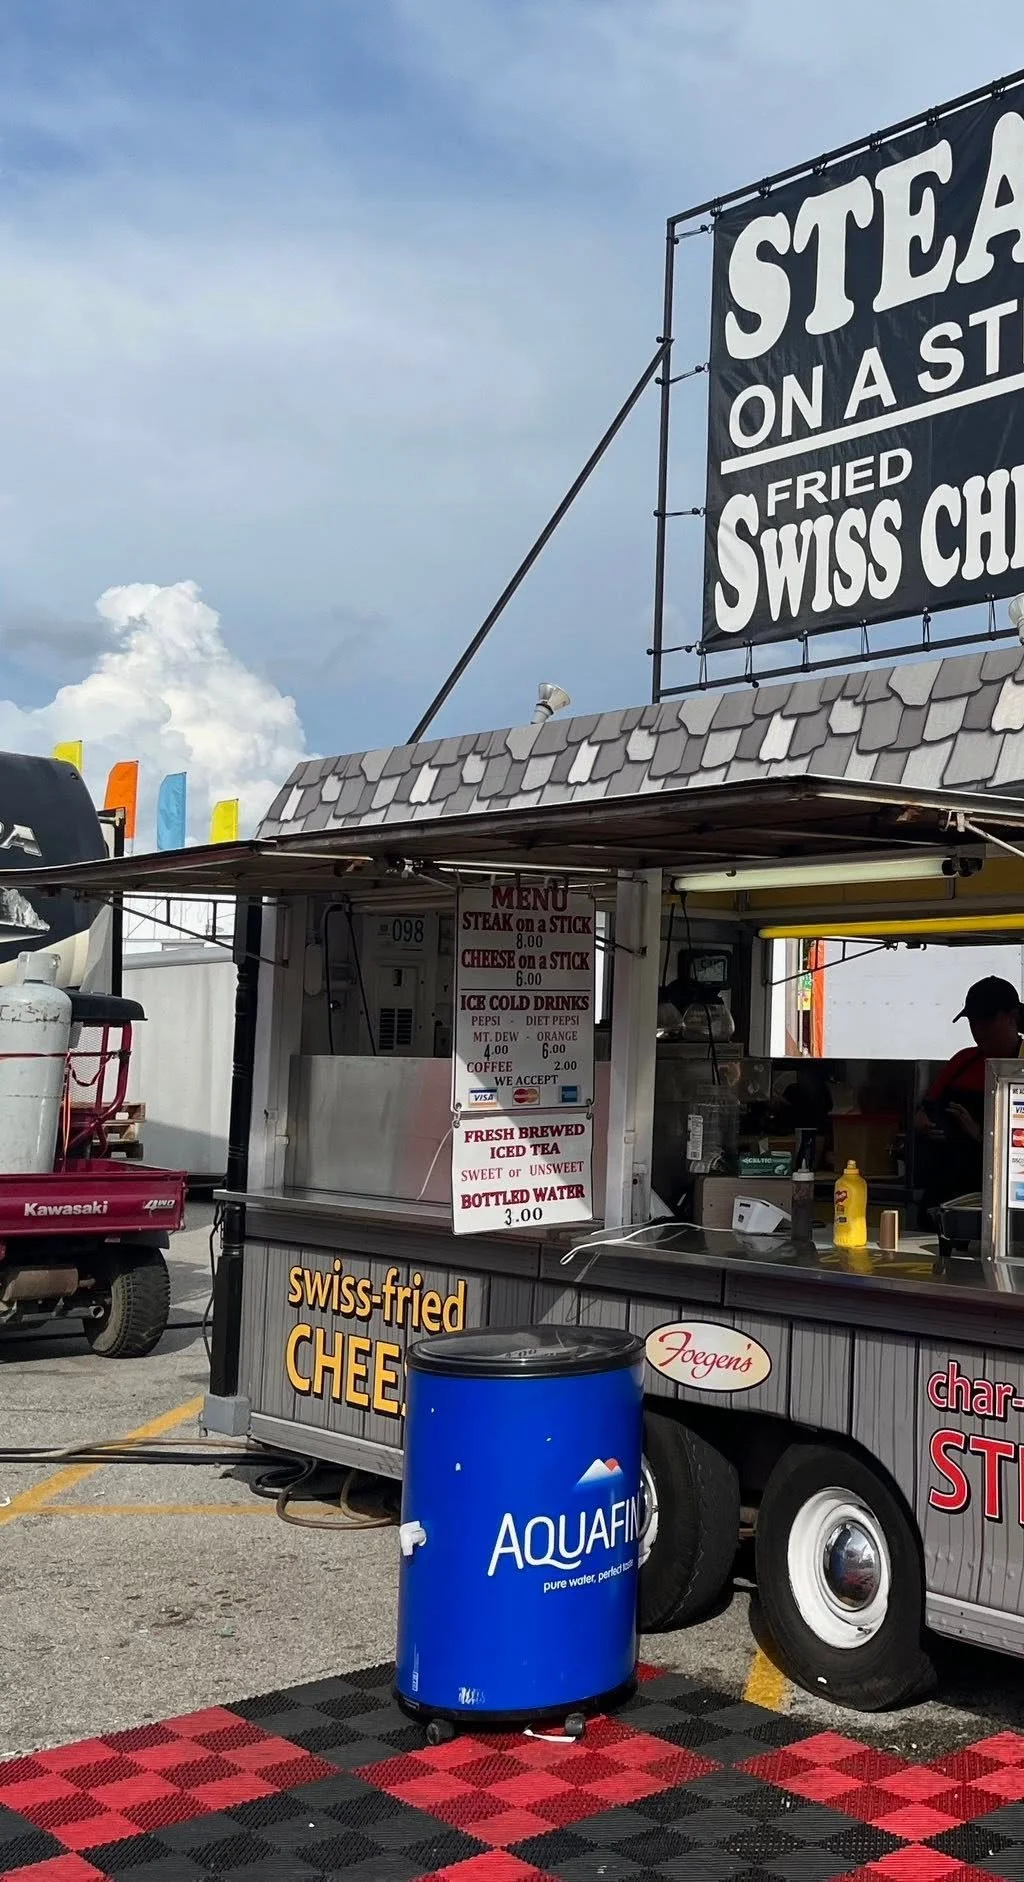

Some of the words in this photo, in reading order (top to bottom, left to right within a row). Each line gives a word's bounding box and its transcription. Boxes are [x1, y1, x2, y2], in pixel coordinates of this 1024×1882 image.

[729, 366, 822, 449] ON
[844, 346, 897, 419] A
[767, 447, 912, 517] FRIED
[714, 494, 903, 633] SWISS
[490, 884, 569, 912] MENU
[393, 918, 424, 943] 098
[462, 911, 514, 931] STEAK
[516, 918, 535, 932] on
[538, 920, 546, 933] a
[549, 916, 593, 934] STICK
[516, 932, 543, 949] 8.00
[461, 949, 516, 969] CHEESE
[518, 955, 535, 969] on
[538, 957, 547, 969] a
[549, 951, 590, 970] STICK
[516, 970, 542, 987] 6.00
[460, 994, 485, 1011] ICE
[489, 994, 530, 1011] COLD
[533, 994, 590, 1011] DRINKS
[471, 1015, 501, 1026] PEPSI
[526, 1015, 551, 1026] DIET
[552, 1015, 580, 1026] PEPSI
[473, 1031, 492, 1042] MT.
[495, 1031, 519, 1042] DEW
[537, 1031, 578, 1042] ORANGE
[484, 1044, 509, 1061] 4.00
[542, 1042, 566, 1059] 6.00
[466, 1061, 513, 1073] COFFEE
[554, 1060, 577, 1071] 2.00
[494, 1076, 512, 1086] WE
[515, 1075, 558, 1086] ACCEPT
[474, 1093, 494, 1102] VISA
[464, 1127, 515, 1143] FRESH
[518, 1123, 586, 1140] BREWED
[490, 1144, 526, 1159] ICED
[530, 1142, 561, 1156] TEA
[461, 1167, 503, 1182] SWEET
[509, 1168, 522, 1178] or
[529, 1161, 585, 1177] UNSWEET
[143, 1199, 175, 1211] 4WD
[461, 1188, 530, 1209] BOTTLED
[533, 1184, 586, 1202] WATER
[24, 1201, 108, 1217] Kawasaki
[504, 1207, 543, 1226] 3.00
[287, 1257, 467, 1335] swiss-fried
[658, 1330, 753, 1380] Foegen's
[286, 1322, 407, 1419] CHEE
[543, 1579, 567, 1593] pure
[569, 1573, 597, 1588] water,
[598, 1564, 622, 1582] perfect
[622, 1558, 634, 1573] taste
